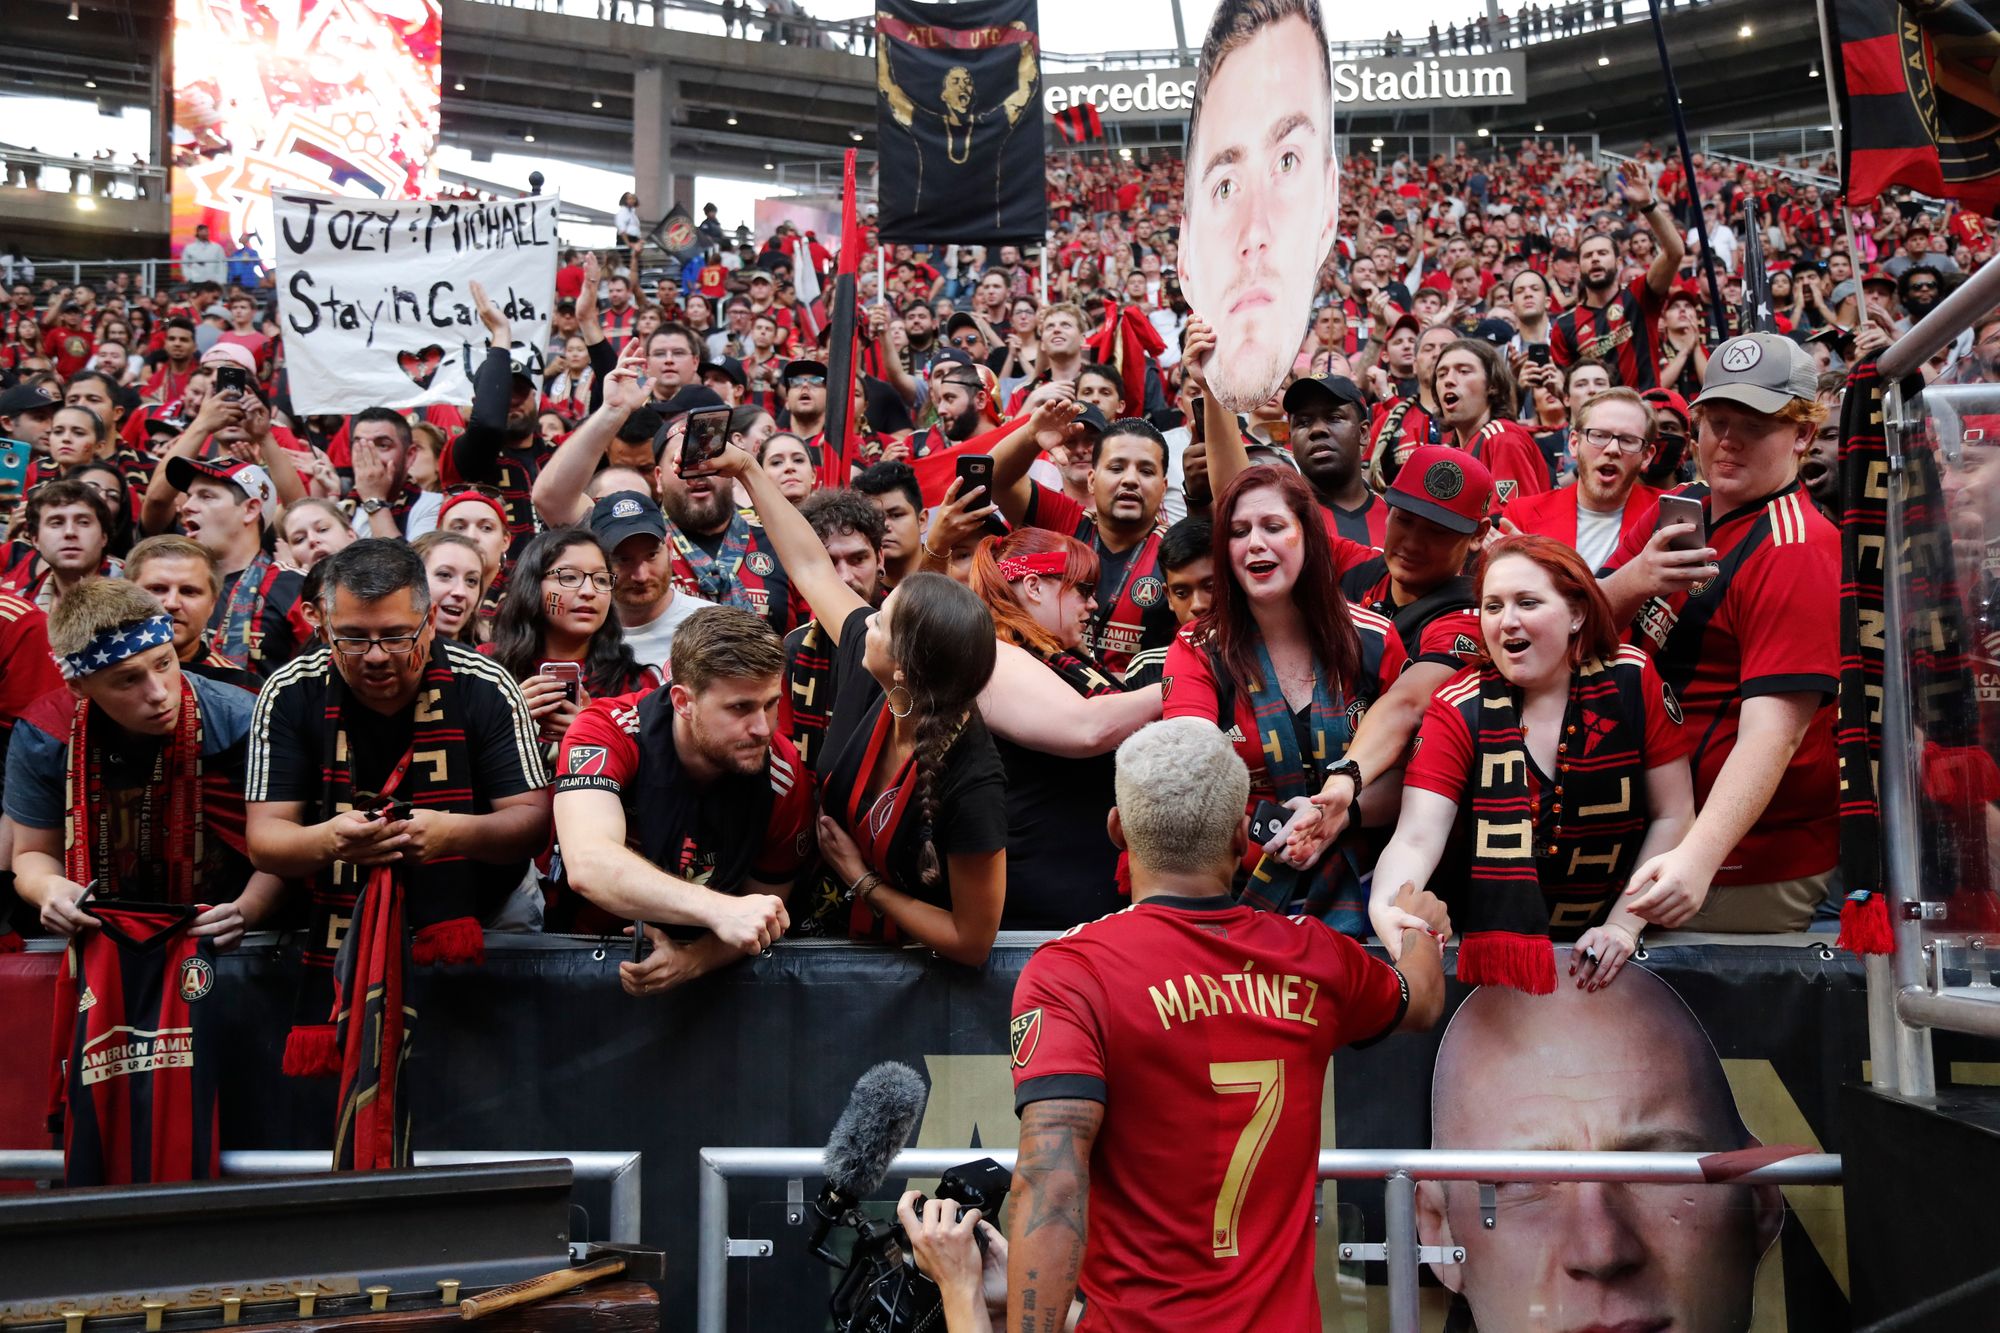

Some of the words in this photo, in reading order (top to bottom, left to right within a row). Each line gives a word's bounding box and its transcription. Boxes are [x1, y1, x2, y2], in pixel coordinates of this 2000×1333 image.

[1044, 73, 1197, 114] ercedes
[1334, 60, 1514, 103] Stadium
[282, 195, 400, 254] JOZY
[703, 270, 720, 287] 10
[288, 269, 384, 348] Stay
[428, 281, 548, 328] Cada.
[614, 501, 641, 516] DARPA
[1103, 627, 1143, 643] FAMILY
[1460, 636, 1476, 652] MLS
[184, 694, 196, 738] CONQUER
[571, 749, 591, 759] MLS
[560, 776, 591, 788] ATLANTA
[593, 776, 621, 791] UNITED
[74, 810, 83, 836] UNITE
[75, 838, 84, 847] &
[76, 849, 86, 887] CONQUE
[98, 866, 108, 894] UNITE
[181, 959, 209, 971] ATLANTA
[1148, 960, 1319, 1031] MARTÍNEZ
[1012, 1018, 1028, 1035] MLS
[82, 1042, 148, 1070] AMERICN
[153, 1037, 193, 1053] FAMLY
[1209, 1058, 1285, 1259] 7
